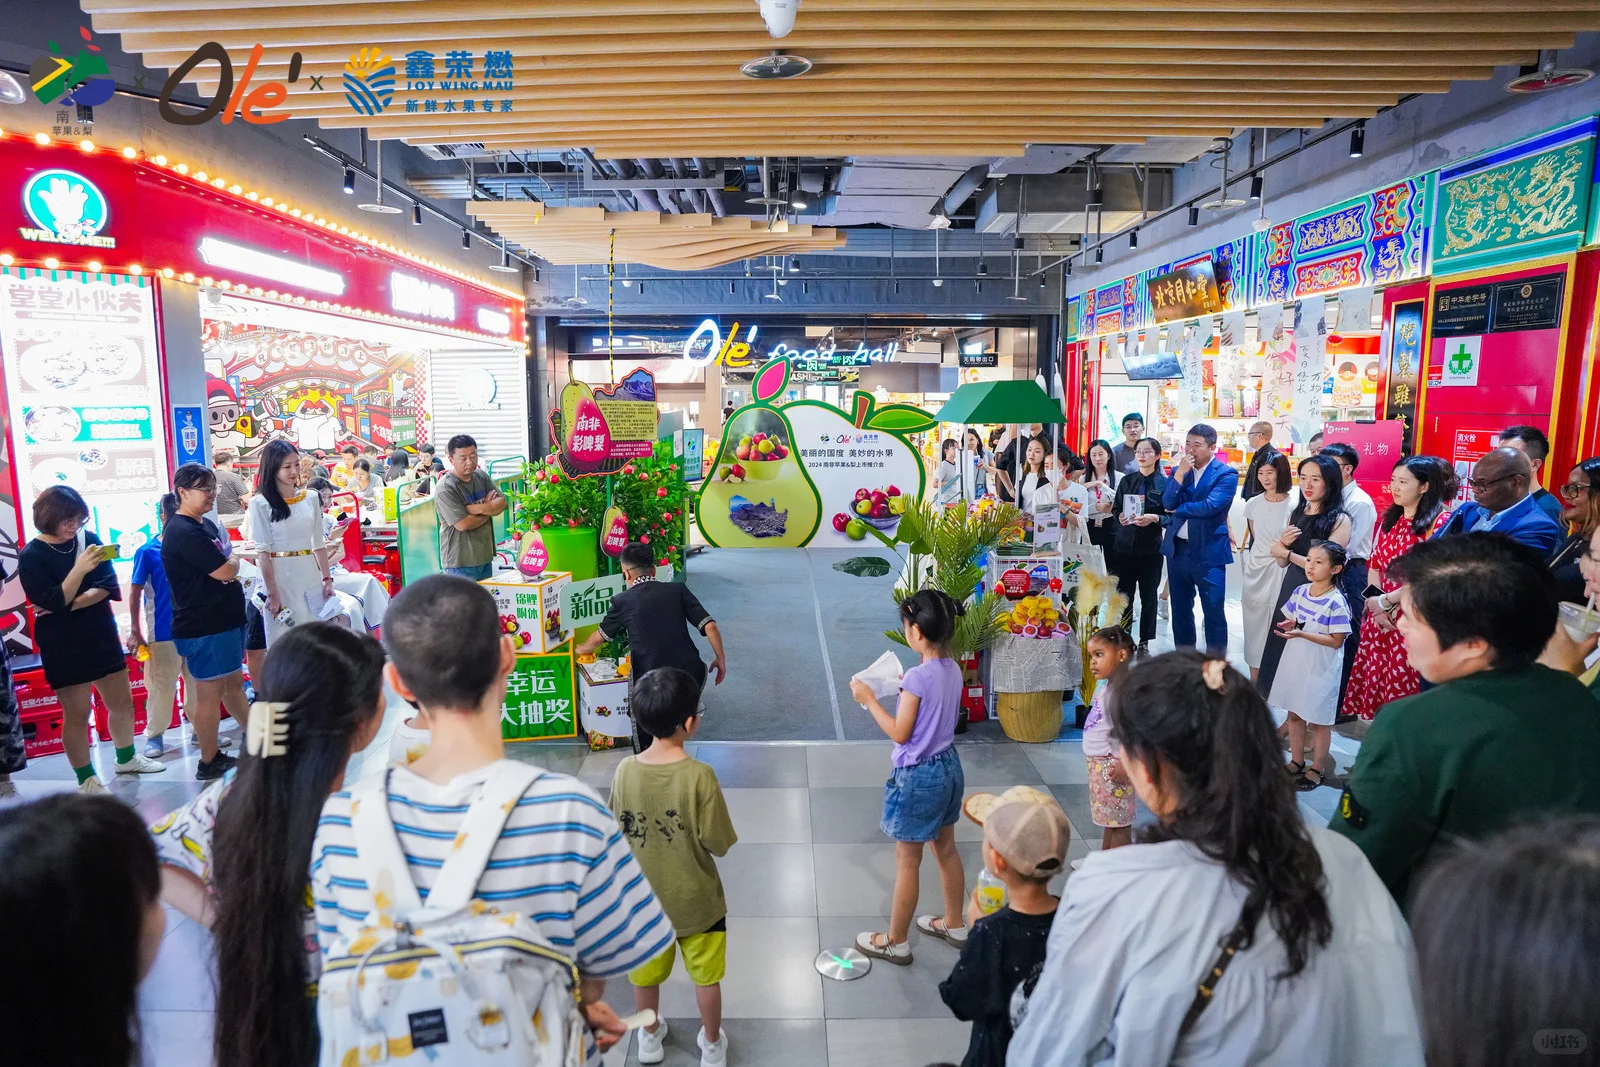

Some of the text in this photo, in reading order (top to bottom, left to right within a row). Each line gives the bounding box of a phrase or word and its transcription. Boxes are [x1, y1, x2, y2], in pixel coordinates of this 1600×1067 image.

[768, 343, 837, 363] food
[852, 341, 900, 363] hall
[576, 414, 601, 431] 南非
[572, 434, 606, 452] 彩啤梨
[1457, 434, 1476, 443] 消火栓
[801, 449, 894, 457] 美丽的国度 美妙的水果
[515, 592, 538, 606] 锦鲤
[571, 582, 613, 620] 新品
[506, 669, 557, 696] 幸运
